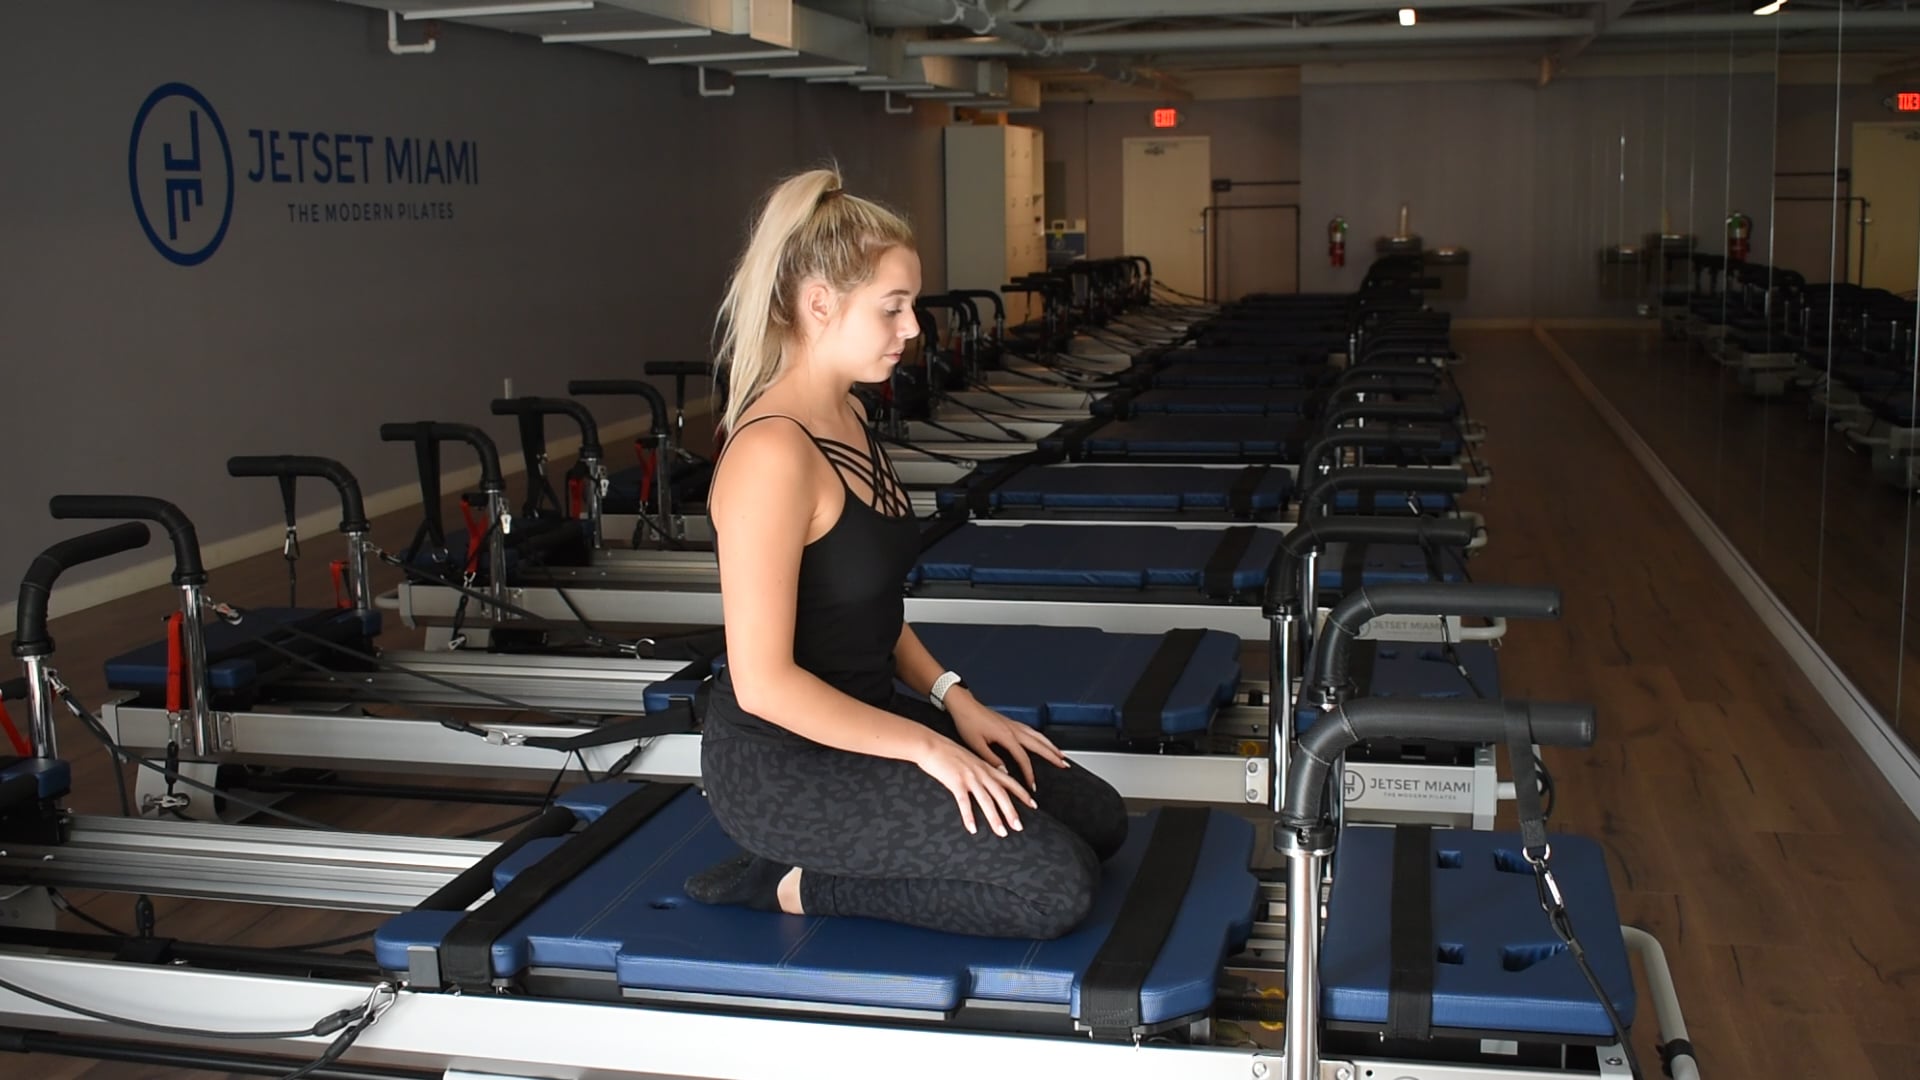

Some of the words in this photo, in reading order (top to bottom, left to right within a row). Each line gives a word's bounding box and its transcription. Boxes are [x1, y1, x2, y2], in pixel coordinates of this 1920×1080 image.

[247, 129, 374, 184] JETSET
[385, 137, 480, 186] MIAMI
[288, 203, 320, 223] THE
[325, 202, 393, 222] MODERN
[399, 201, 455, 220] PILATES
[1370, 777, 1421, 791] JETSET
[1424, 780, 1471, 793] MIAMI
